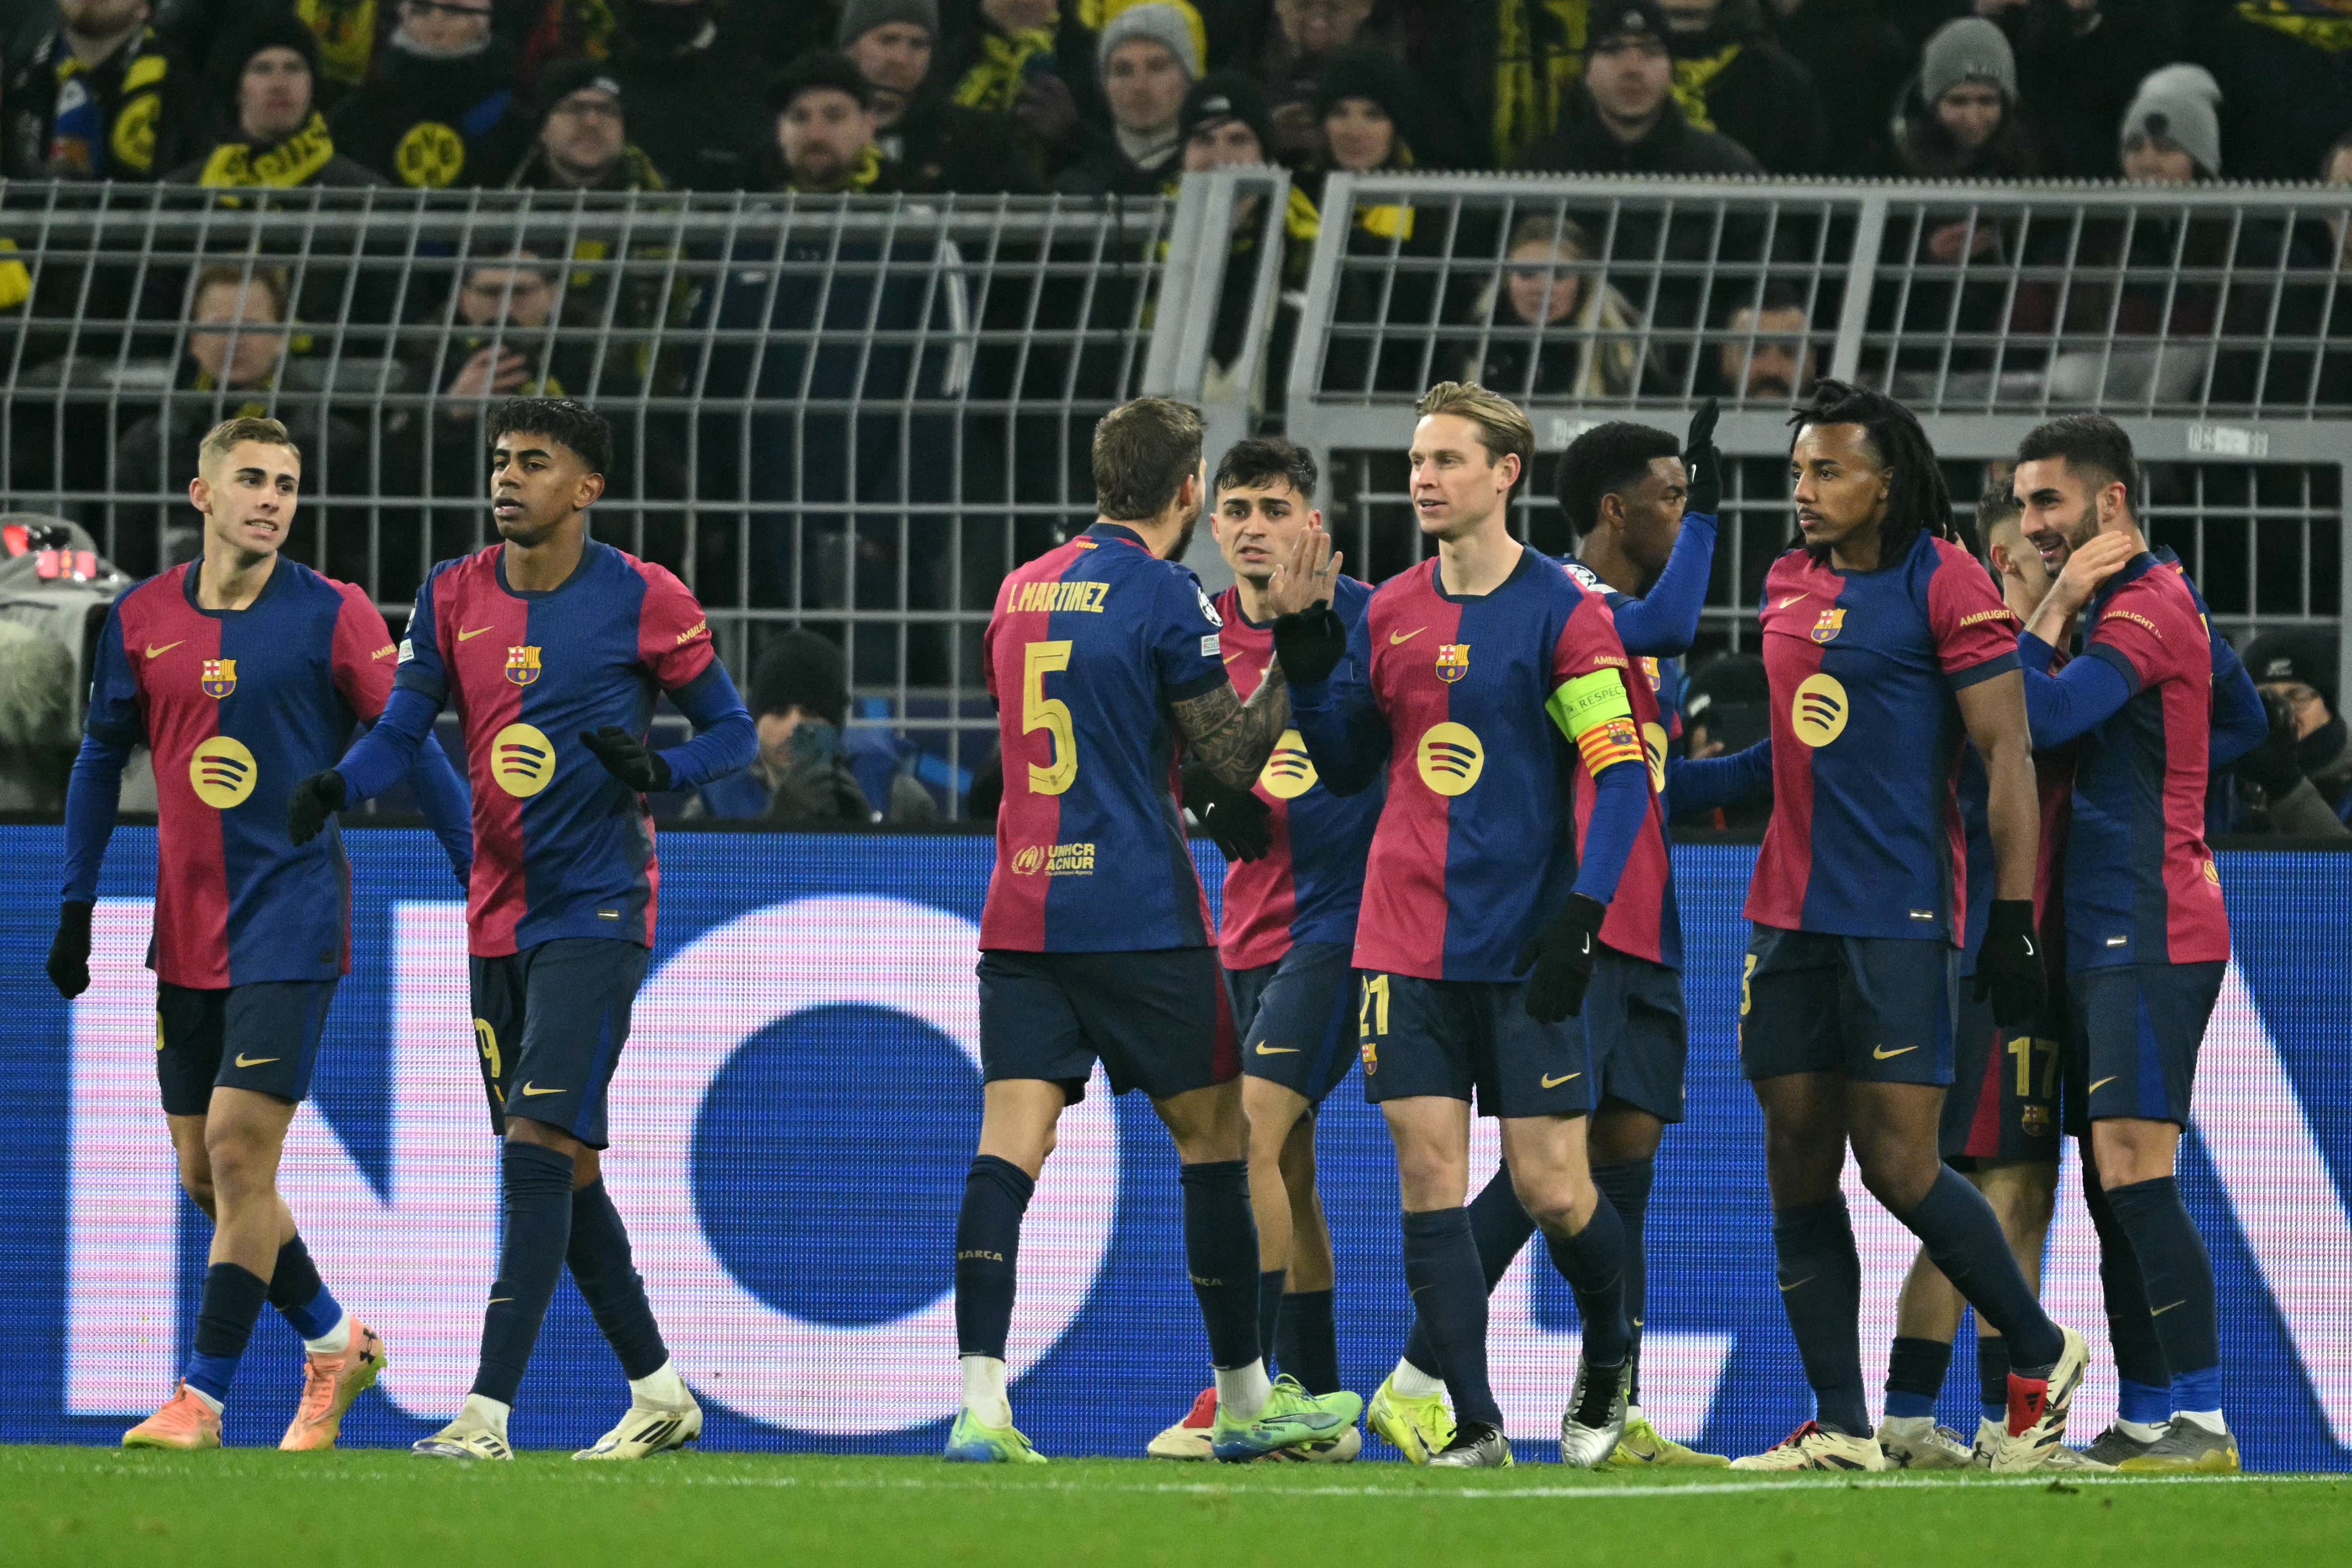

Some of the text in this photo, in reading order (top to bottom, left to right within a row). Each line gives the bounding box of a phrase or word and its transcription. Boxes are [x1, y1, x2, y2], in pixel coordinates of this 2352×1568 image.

[1017, 581, 1110, 613] MARTINEZ
[1960, 610, 2010, 626] AMBILIGHT
[1579, 686, 1624, 708] RESPEC
[1023, 640, 1078, 795] 5
[1045, 856, 1094, 871] ACNUR
[1048, 842, 1095, 863] UNHCR
[2008, 1036, 2060, 1099] 17
